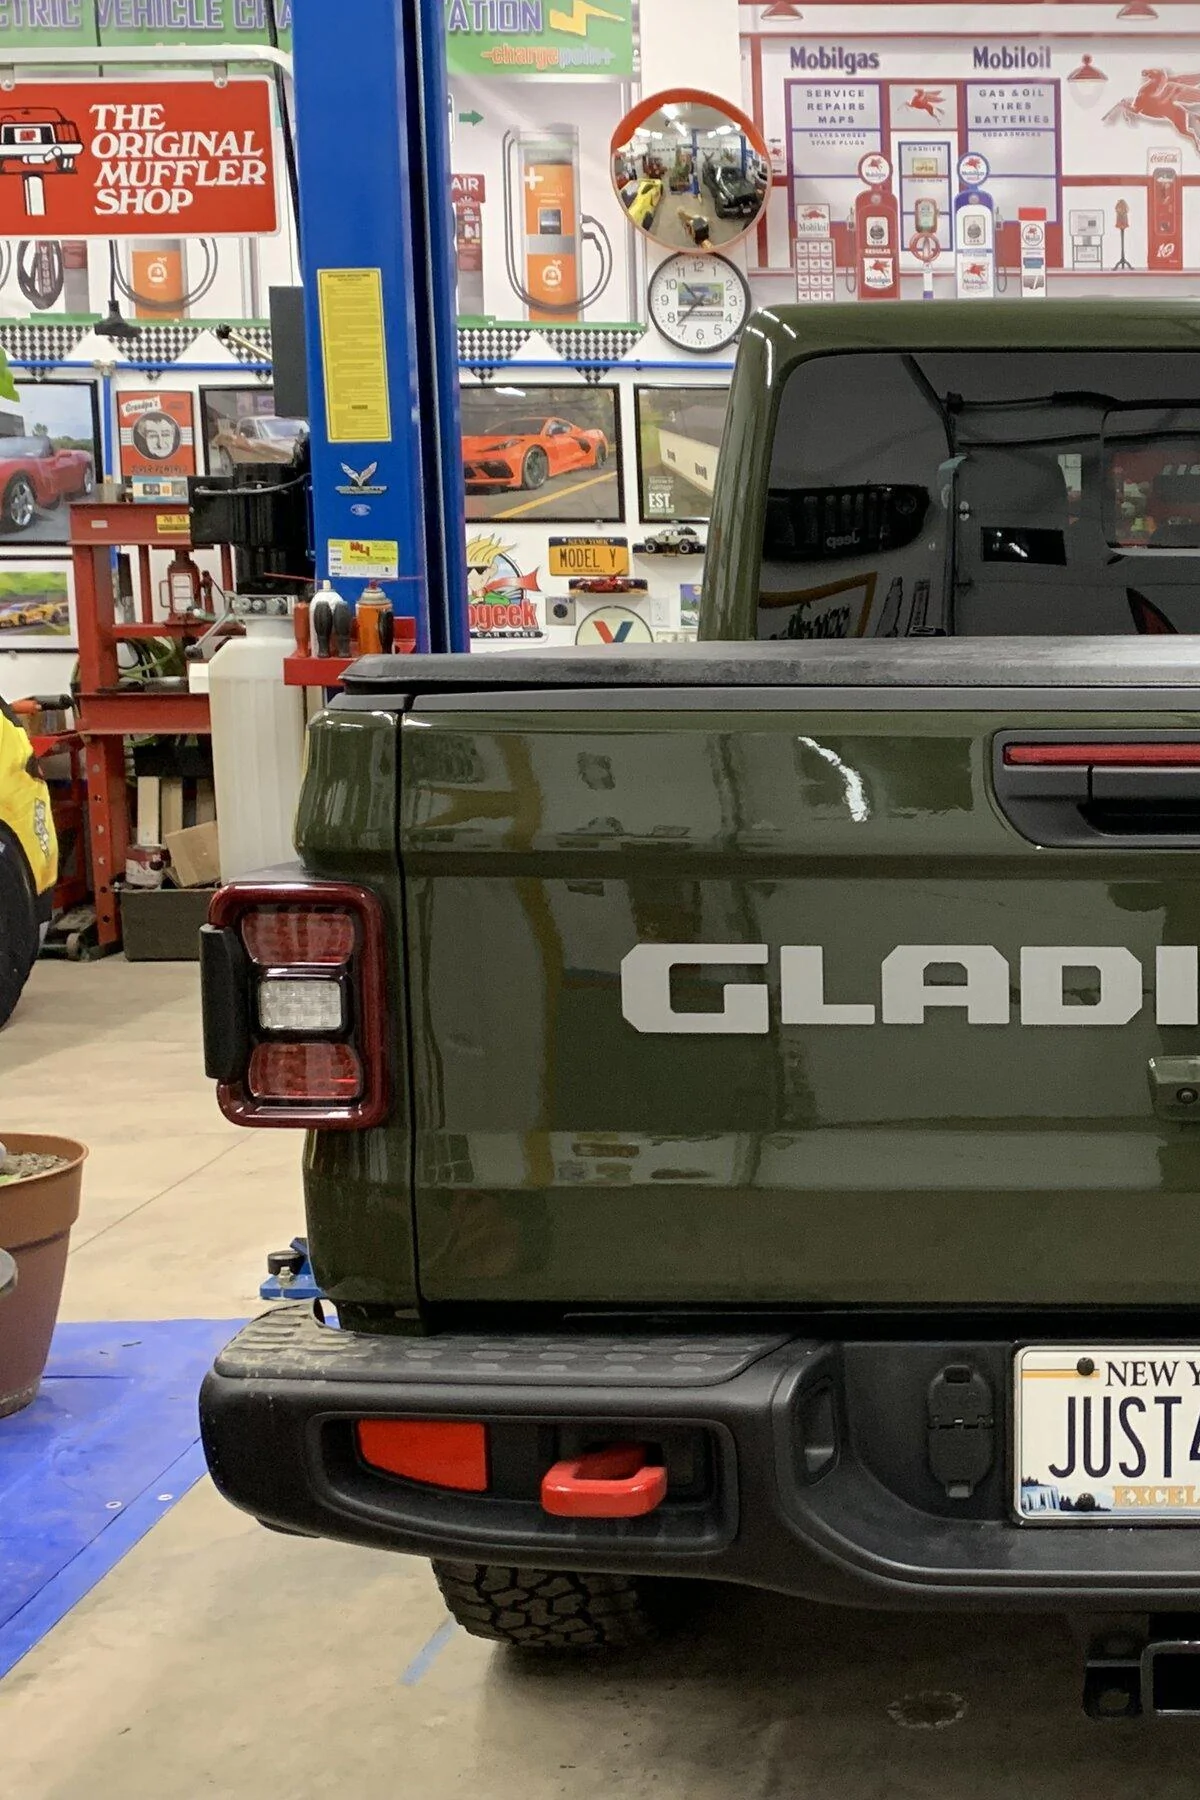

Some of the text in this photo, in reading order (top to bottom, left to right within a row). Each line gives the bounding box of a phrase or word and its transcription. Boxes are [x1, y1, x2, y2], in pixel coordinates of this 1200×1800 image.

[96, 0, 223, 29] VEHICLE
[447, 0, 543, 32] ATION
[790, 46, 880, 75] Mobilgas
[973, 46, 1051, 69] Mobiloil
[806, 89, 865, 98] SERVICE
[979, 89, 1005, 97] GAS
[1022, 88, 1044, 97] OIL
[806, 102, 865, 111] REPAIRS
[992, 102, 1032, 110] TIRES
[88, 103, 166, 130] THE
[818, 115, 855, 124] MAPS
[974, 115, 1050, 124] BATTERIES
[90, 131, 265, 159] ORIGINAL
[93, 159, 268, 187] MUFFLER
[451, 177, 480, 192] AIR
[94, 188, 194, 215] SHOP
[1156, 242, 1176, 258] 10
[677, 266, 686, 277] 11
[693, 261, 704, 272] 12
[666, 279, 678, 290] 10
[725, 280, 734, 291] 2
[660, 294, 669, 306] 9
[729, 295, 738, 307] 3
[667, 312, 676, 323] 8
[696, 328, 705, 340] 6
[713, 323, 722, 335] 5
[560, 548, 616, 568] MODEL Y
[1105, 1360, 1190, 1387] NEW
